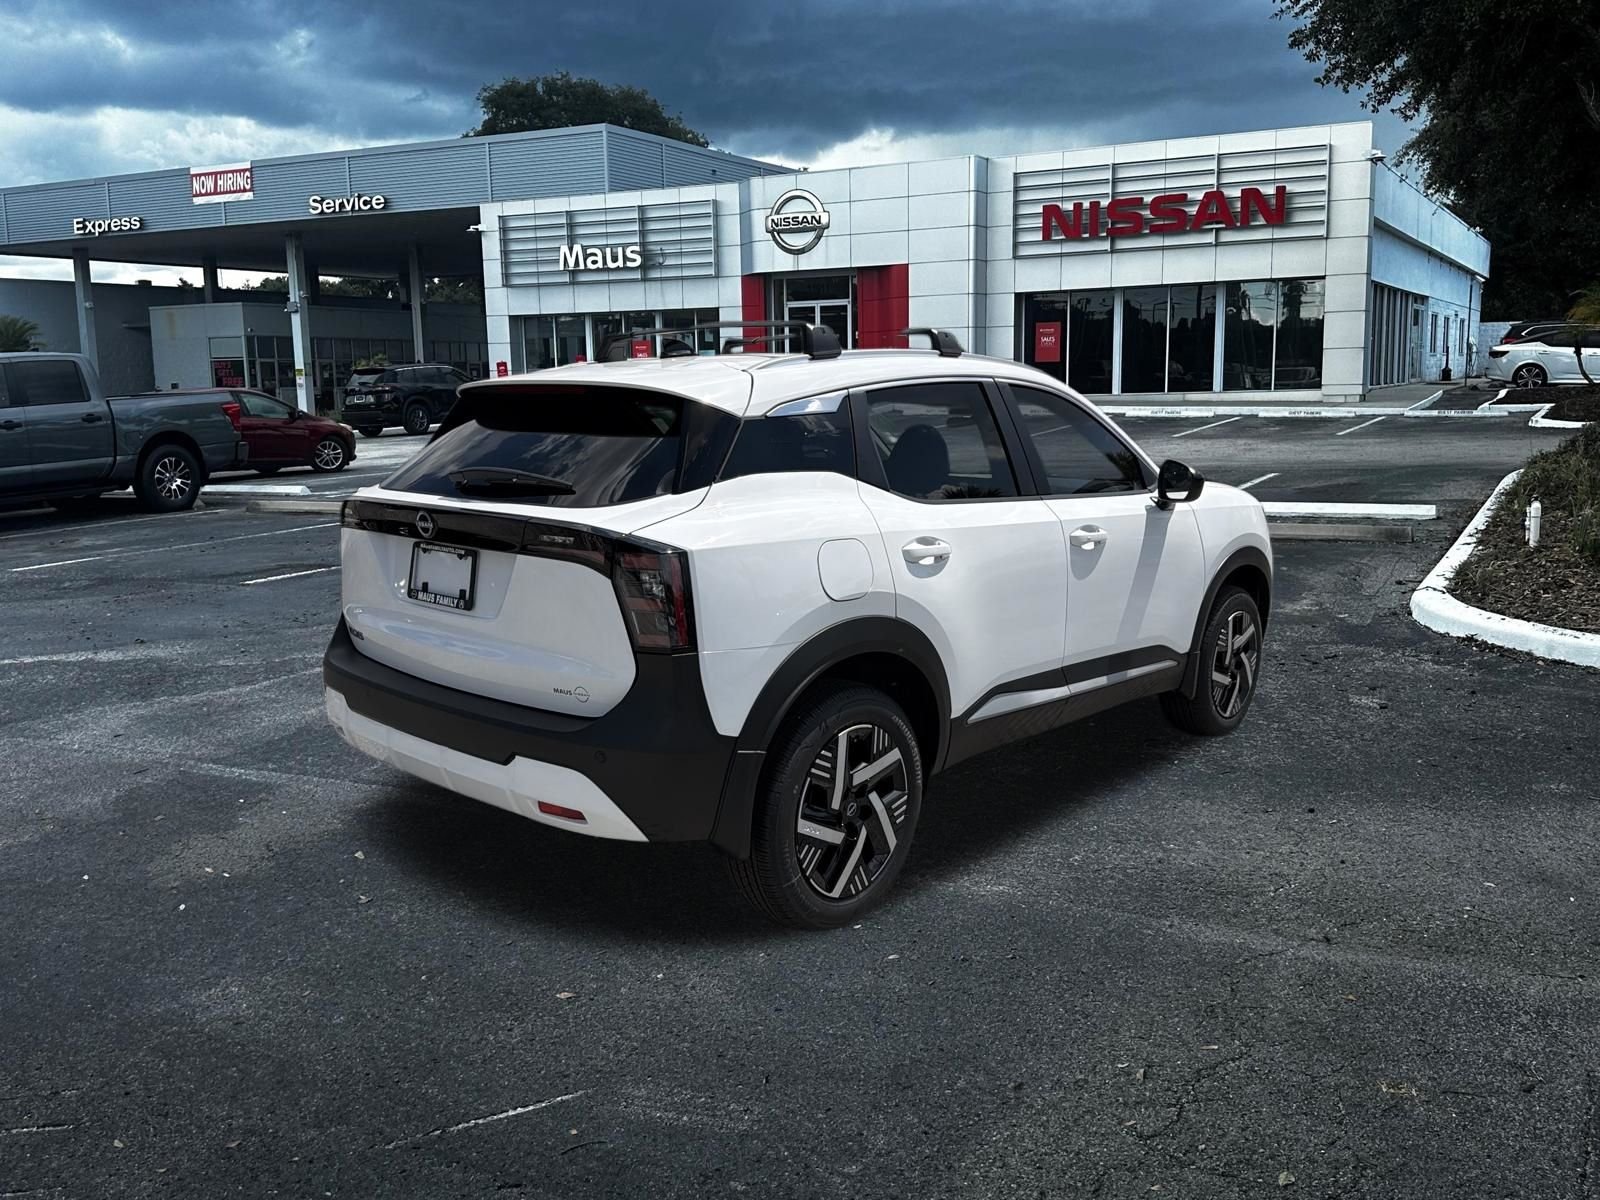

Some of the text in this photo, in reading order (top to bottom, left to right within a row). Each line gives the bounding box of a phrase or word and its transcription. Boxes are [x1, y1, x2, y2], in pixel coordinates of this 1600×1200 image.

[192, 171, 251, 195] NOW HIRING
[309, 193, 385, 214] Service
[1042, 185, 1287, 241] NISSAN
[73, 216, 141, 236] Express
[770, 215, 822, 228] NISSAN
[559, 243, 642, 271] Maus
[418, 591, 458, 607] MAUS FAMILY
[553, 687, 572, 696] MAUS
